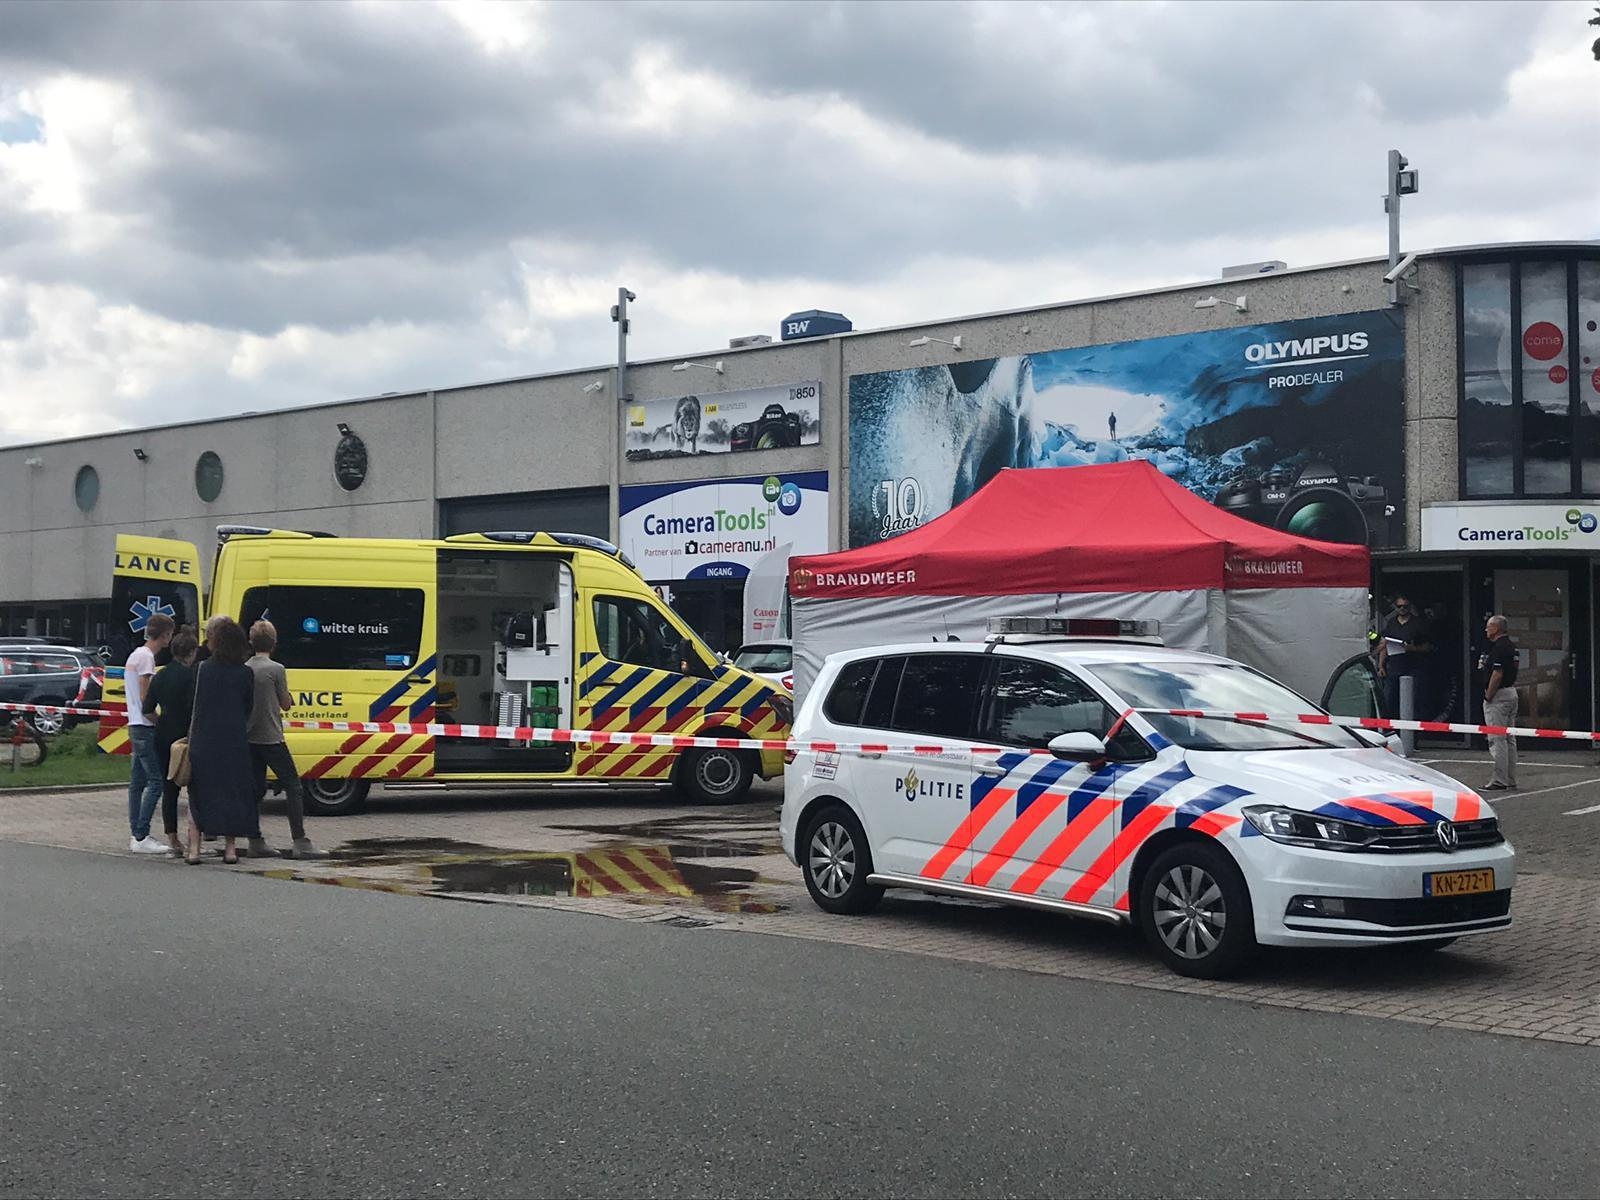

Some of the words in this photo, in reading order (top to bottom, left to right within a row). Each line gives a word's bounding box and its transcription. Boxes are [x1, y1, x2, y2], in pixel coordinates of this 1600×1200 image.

[1245, 332, 1369, 362] OLYMPUS
[1268, 370, 1343, 389] PRODEALER
[789, 387, 815, 400] D850
[1300, 477, 1338, 485] OLYMPUS
[880, 476, 922, 520] 10
[880, 514, 920, 538] Jaar
[644, 548, 667, 558] Partner
[669, 548, 682, 556] van
[699, 536, 776, 555] cameranu.nl
[115, 554, 191, 575] LANCE
[706, 567, 733, 577] INGANG
[1244, 561, 1303, 574] BRANDWEER
[816, 570, 916, 586] BRANDWEER
[322, 622, 355, 634] witte
[358, 622, 389, 634] kruis
[896, 778, 963, 801] POLITIE
[1435, 872, 1489, 893] KN-272-T
